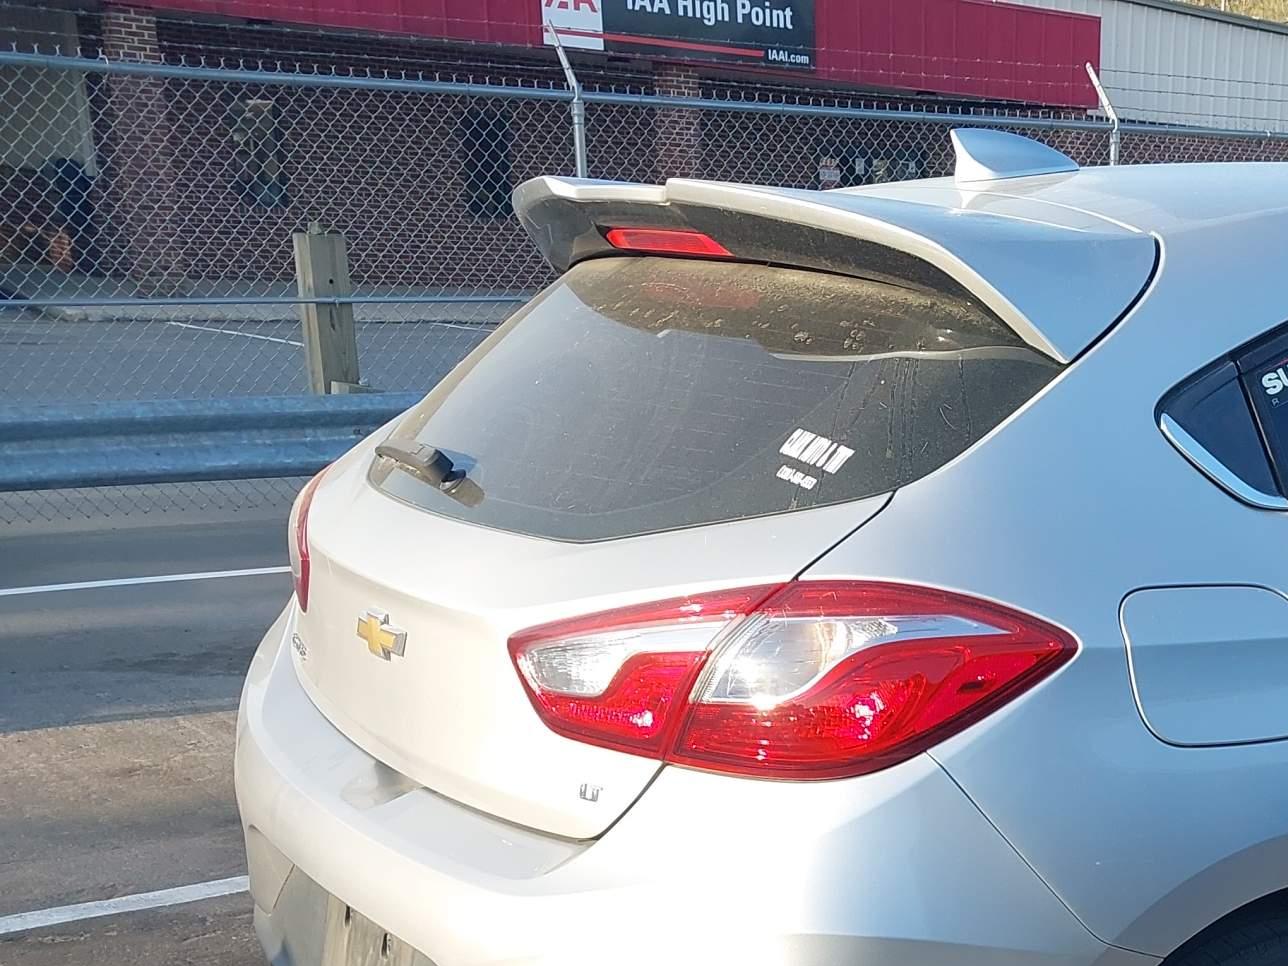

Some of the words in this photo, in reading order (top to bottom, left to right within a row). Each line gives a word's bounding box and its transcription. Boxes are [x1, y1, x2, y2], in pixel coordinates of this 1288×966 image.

[677, 0, 729, 26] High
[736, 0, 793, 29] Point
[767, 48, 810, 64] IAAI.com
